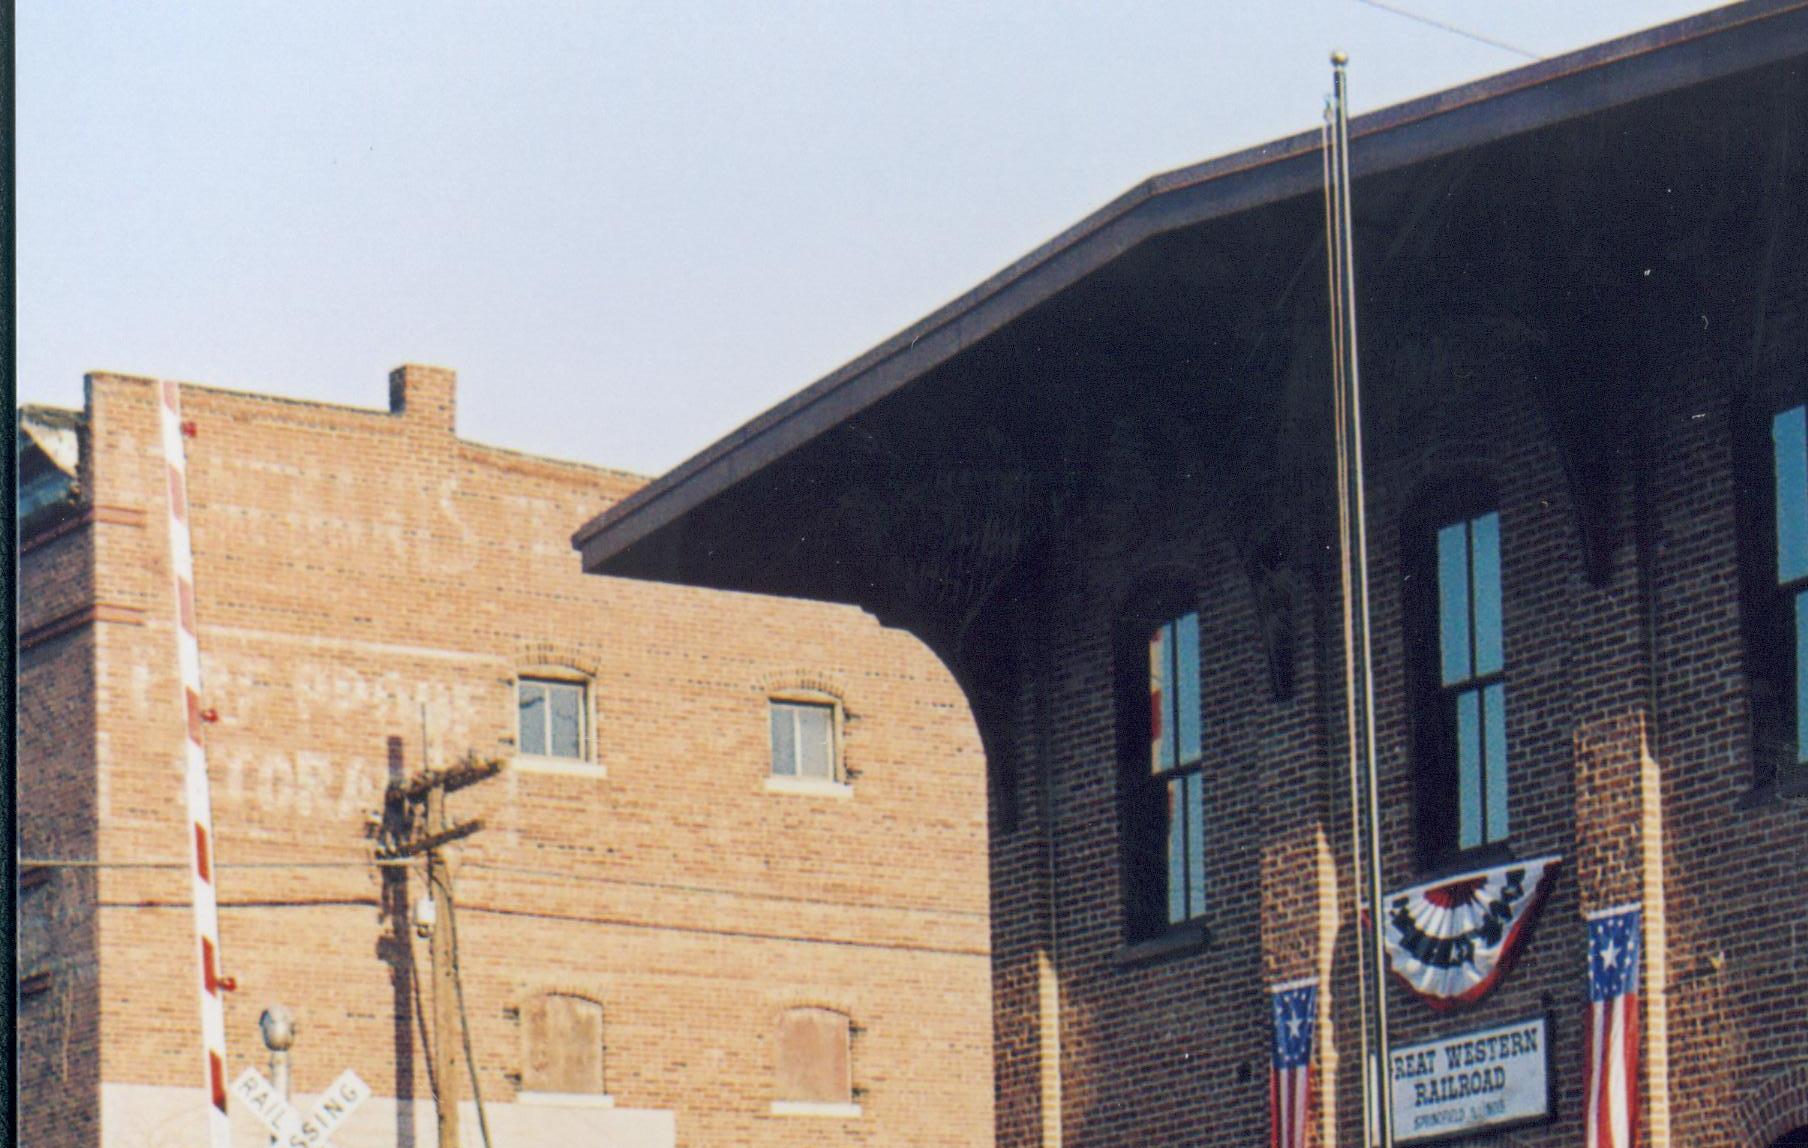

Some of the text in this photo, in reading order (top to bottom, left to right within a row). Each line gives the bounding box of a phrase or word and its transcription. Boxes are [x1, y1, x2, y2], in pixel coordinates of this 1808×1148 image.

[1391, 1027, 1539, 1081] REAT WESTERN
[238, 1076, 288, 1131] RAIL
[1414, 1065, 1506, 1108] RAILROAD
